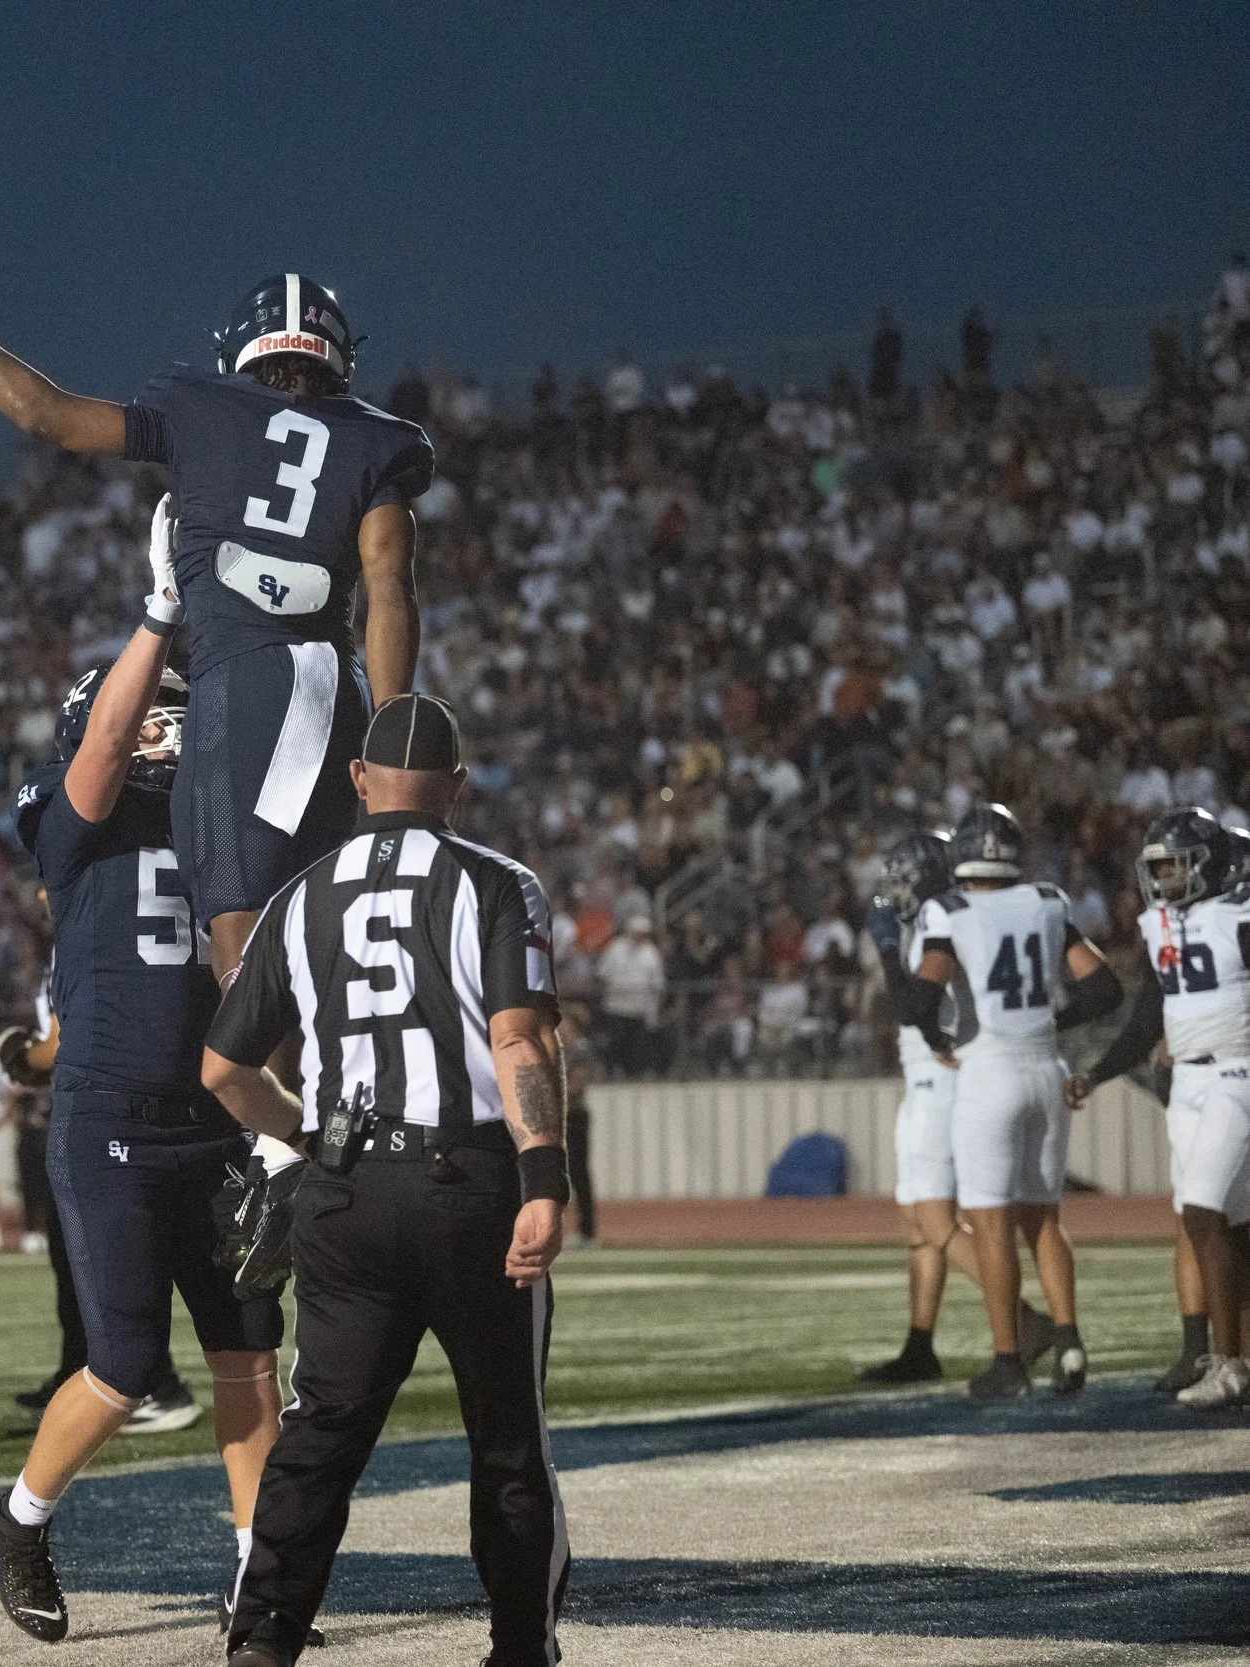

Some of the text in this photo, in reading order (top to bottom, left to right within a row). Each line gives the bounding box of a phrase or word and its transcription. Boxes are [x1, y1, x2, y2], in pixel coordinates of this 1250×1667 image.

[258, 334, 326, 354] Riddell
[243, 408, 330, 538] 3
[258, 573, 290, 608] SV
[137, 847, 211, 966] 5
[344, 889, 416, 1020] S
[987, 932, 1049, 1010] 41
[108, 1140, 130, 1163] SV
